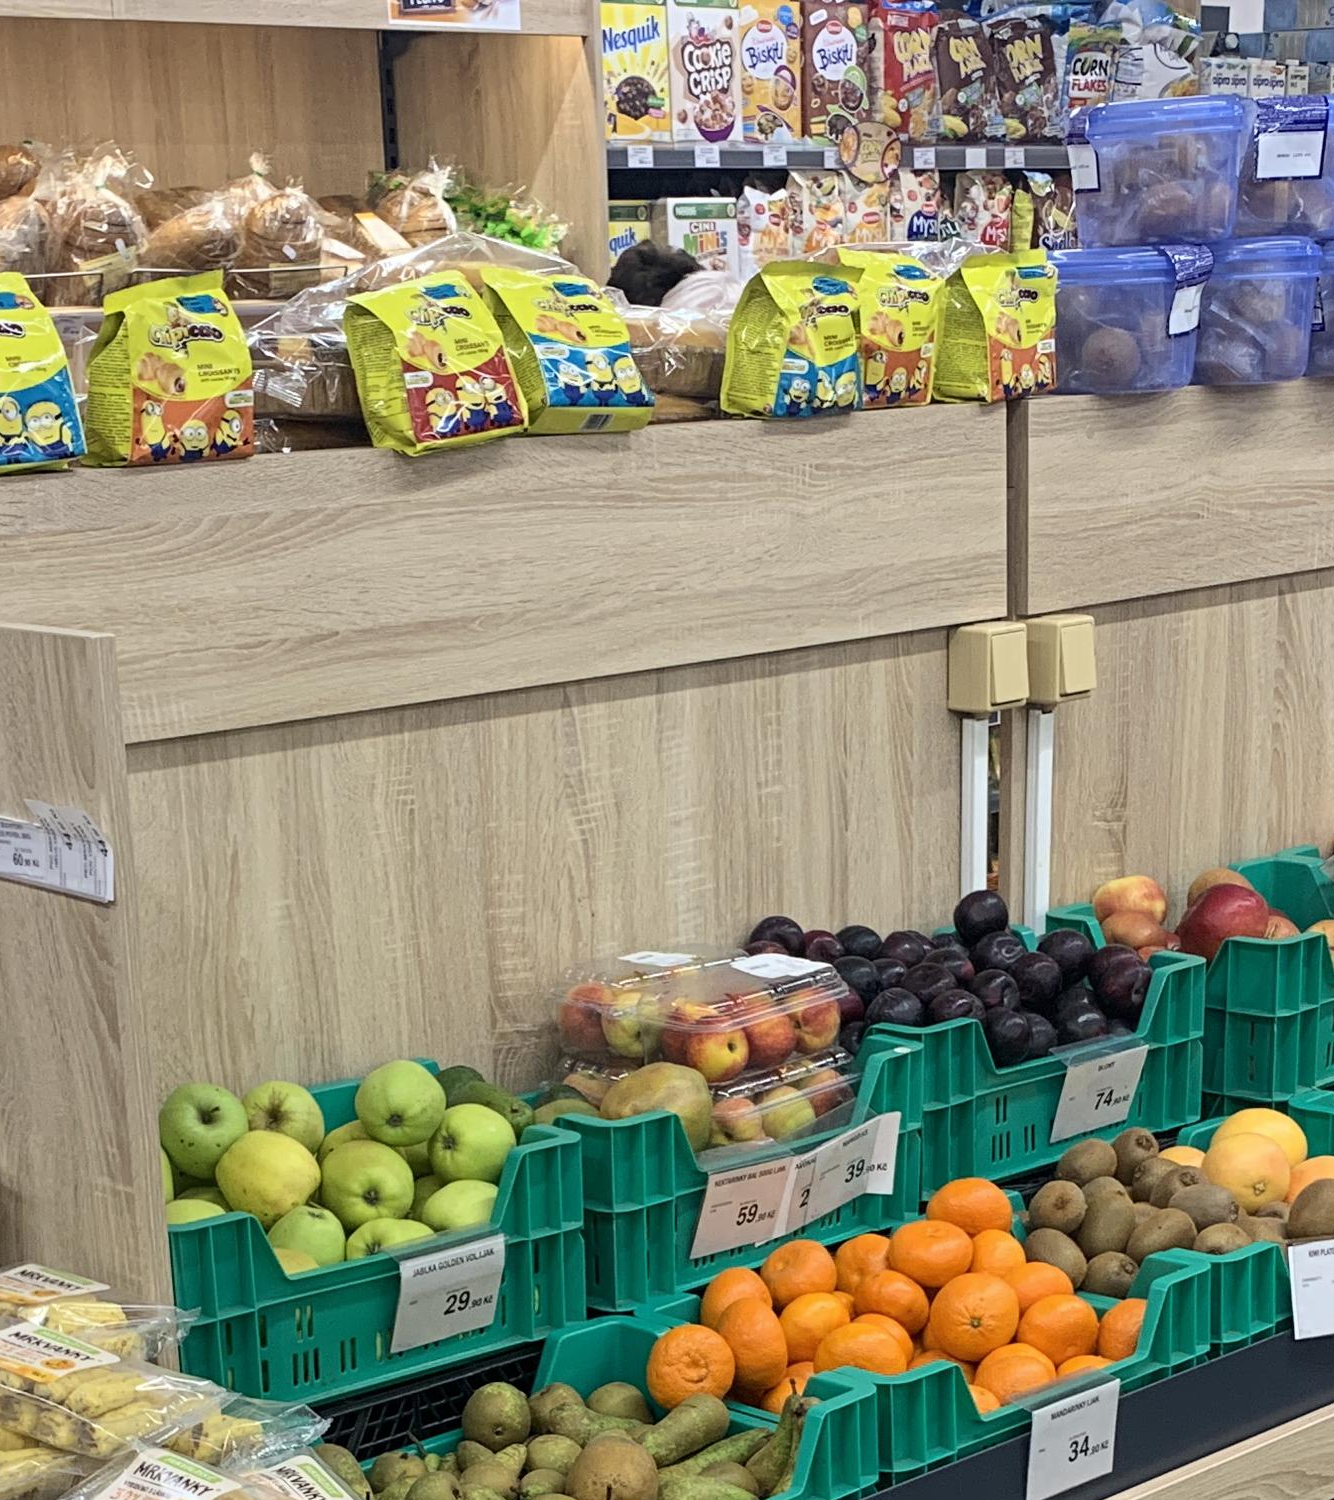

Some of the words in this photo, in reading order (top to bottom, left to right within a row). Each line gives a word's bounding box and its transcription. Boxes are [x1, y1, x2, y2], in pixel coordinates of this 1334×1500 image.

[602, 16, 660, 52] Nesquik
[1072, 57, 1108, 76] CORN
[1071, 77, 1107, 93] FLAKES
[690, 222, 715, 232] CINI
[609, 228, 636, 253] quik
[877, 1162, 888, 1172] Kč
[736, 1203, 766, 1227] 59,90
[412, 1264, 438, 1278] JABLKA
[439, 1256, 464, 1272] GOLDEN
[444, 1289, 482, 1316] 29,90
[483, 1293, 494, 1304] Kč
[1068, 1436, 1099, 1462] 34,90
[134, 1461, 214, 1496] MRKVANKY
